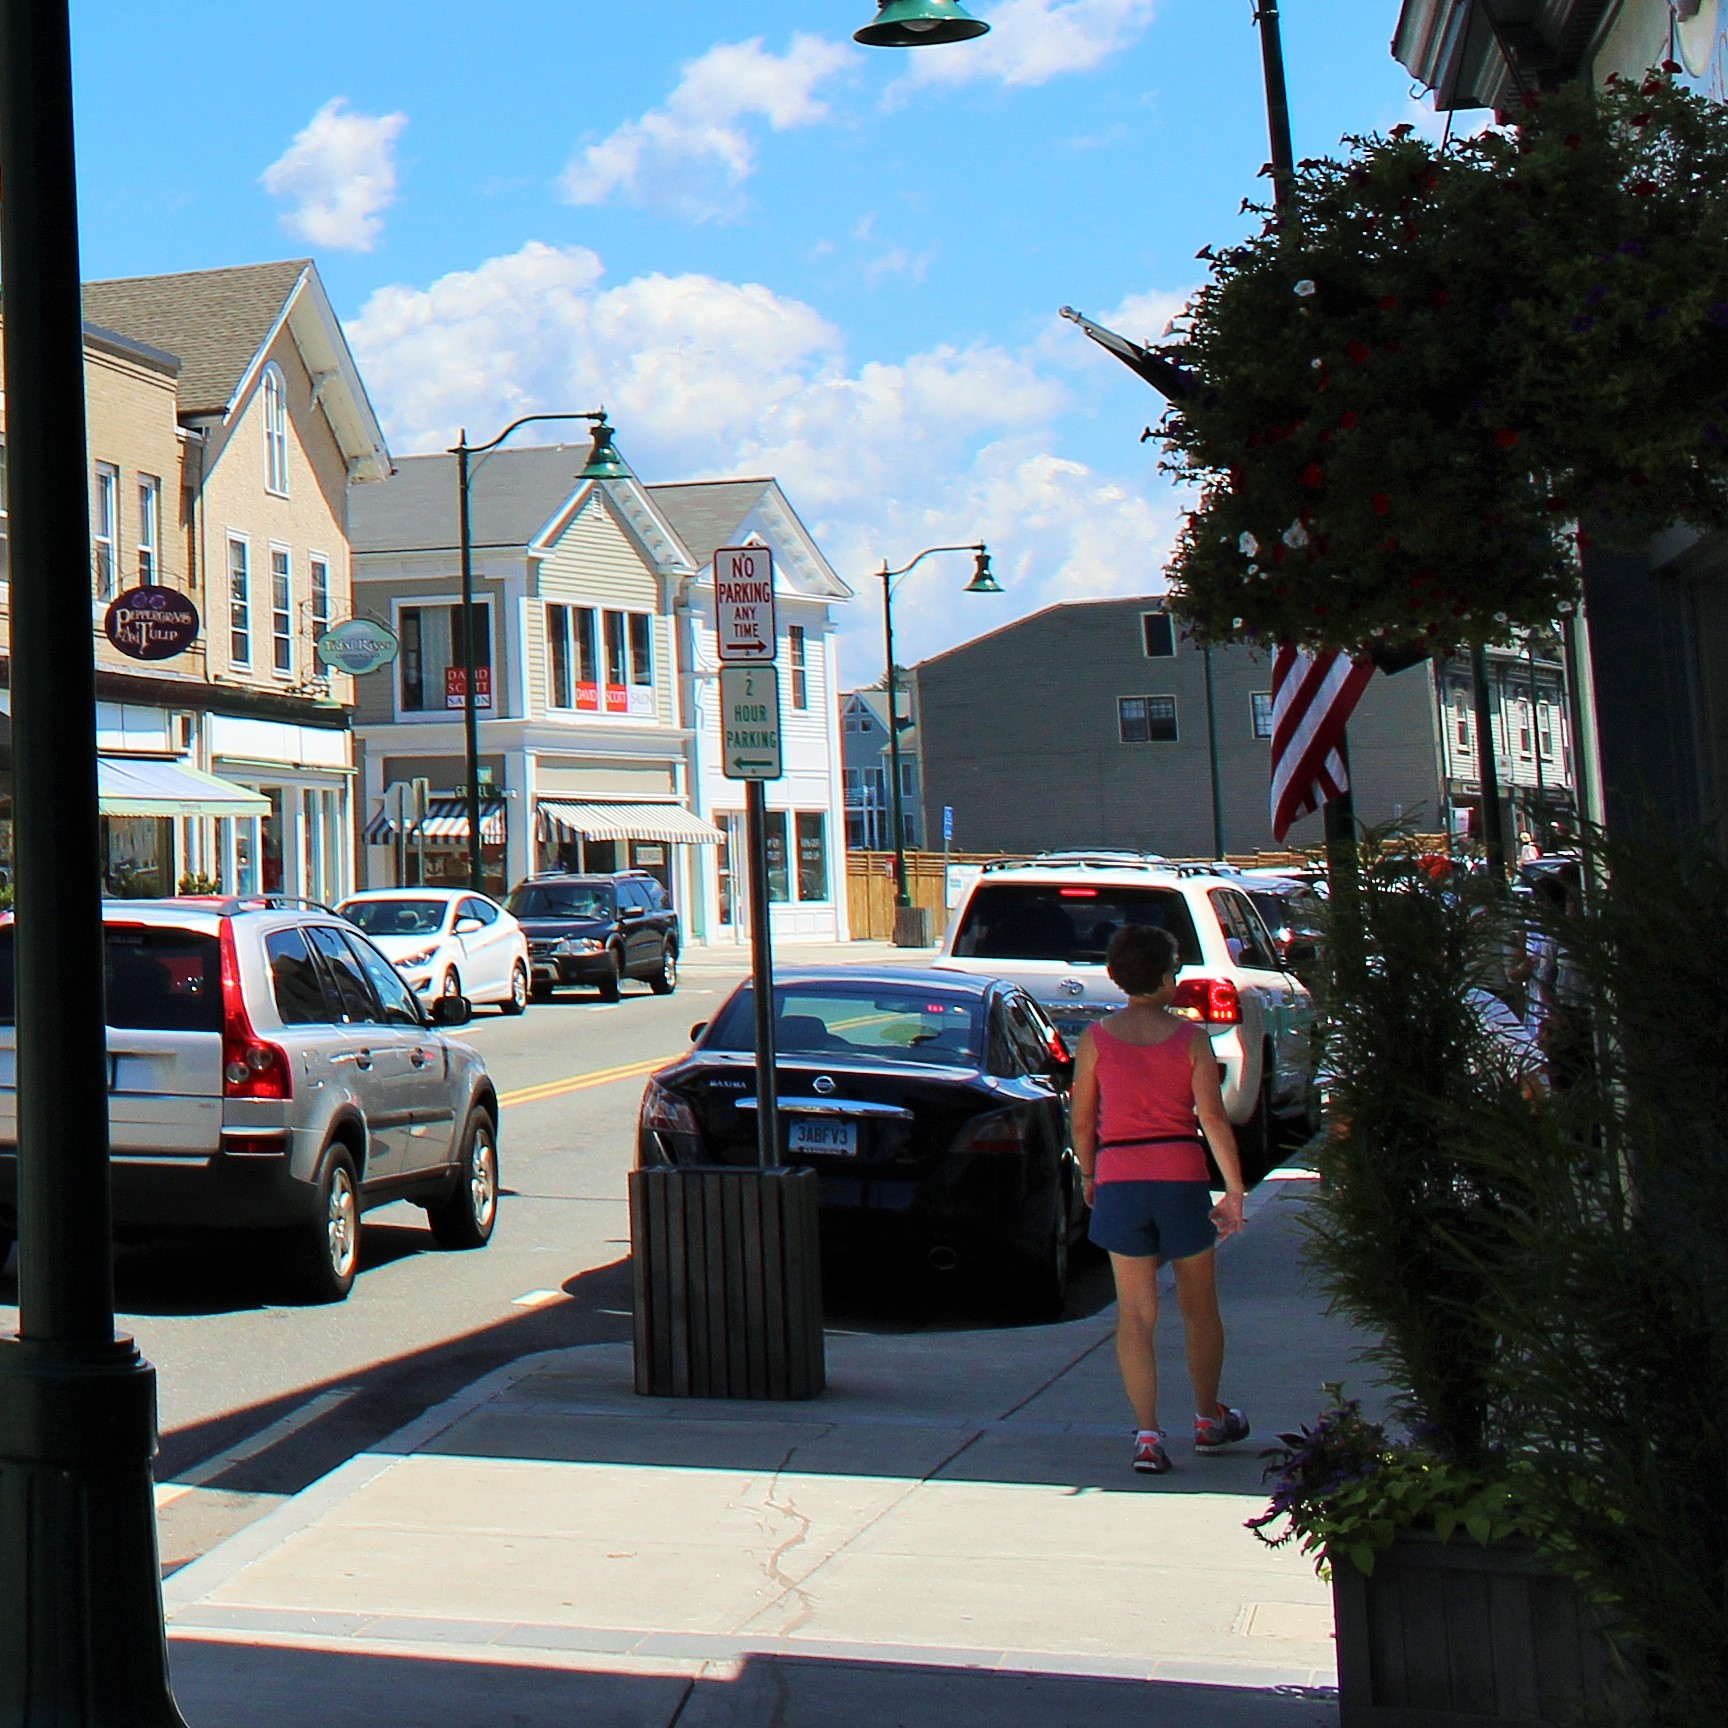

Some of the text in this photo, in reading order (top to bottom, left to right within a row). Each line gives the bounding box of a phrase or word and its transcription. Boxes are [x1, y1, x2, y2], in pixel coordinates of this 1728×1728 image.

[732, 557, 755, 579] NO
[719, 582, 770, 604] PARKING
[734, 606, 757, 621] ANY
[733, 623, 761, 638] TIME
[448, 669, 489, 680] DAID
[448, 682, 490, 693] SCTT
[745, 680, 755, 697] 2
[734, 705, 767, 722] HOUR
[726, 731, 777, 749] PARKING
